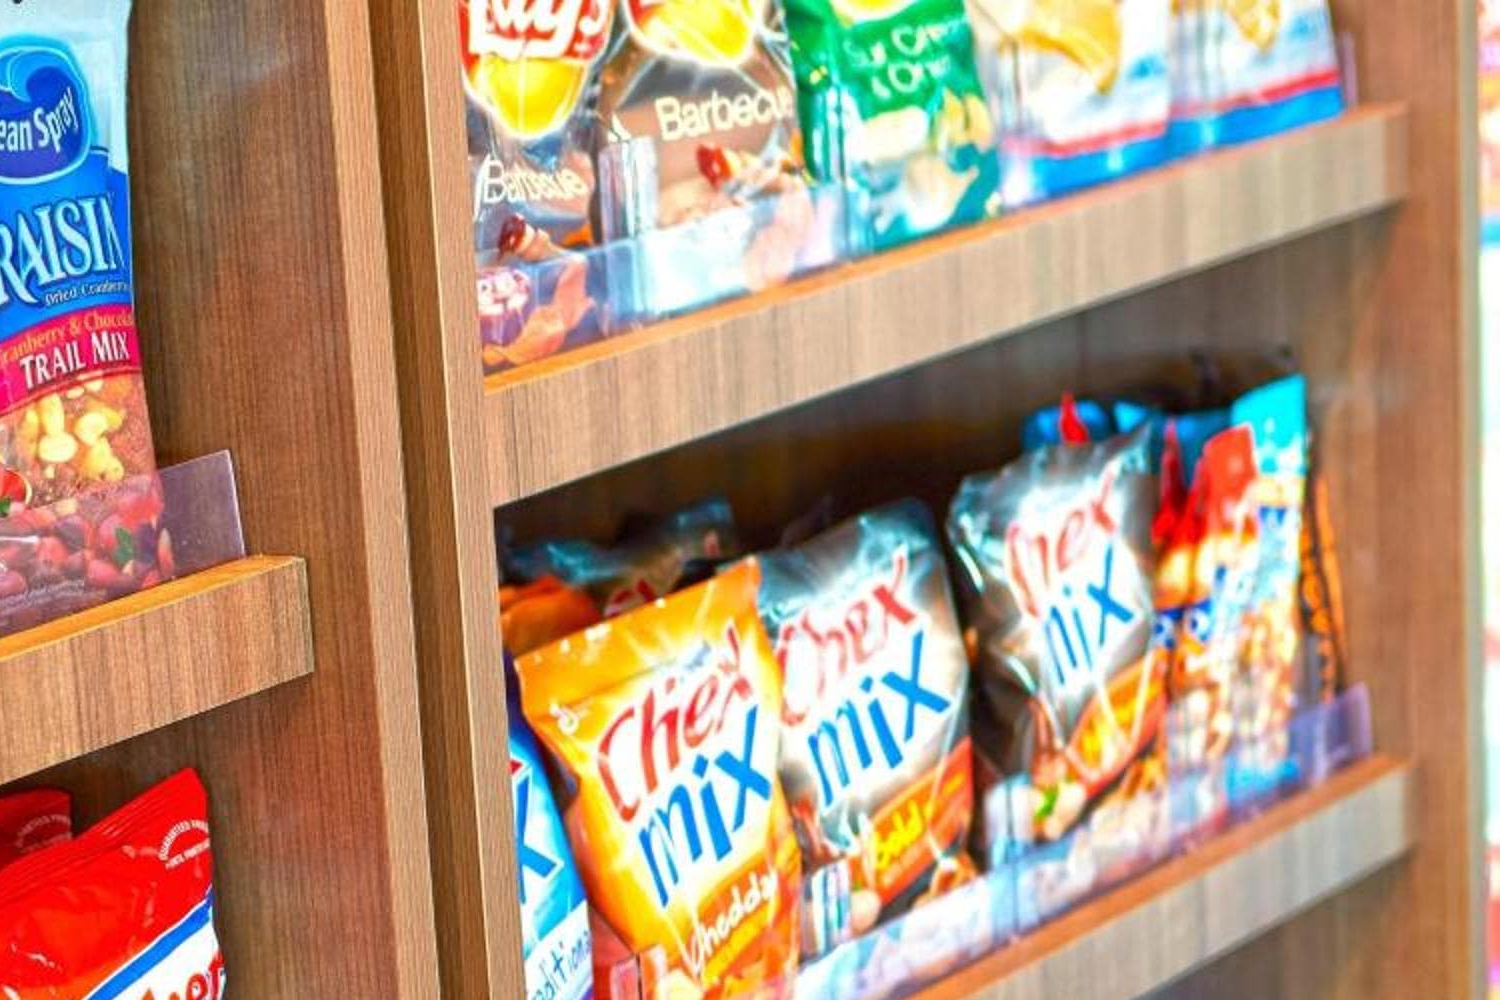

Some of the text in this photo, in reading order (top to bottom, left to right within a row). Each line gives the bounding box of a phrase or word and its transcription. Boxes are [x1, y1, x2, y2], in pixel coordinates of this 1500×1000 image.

[34, 86, 79, 153] Spray
[19, 330, 132, 391] TRAIL MIX
[67, 317, 83, 335] &
[597, 623, 755, 824] Chex
[777, 540, 920, 730] Chex
[805, 630, 952, 810] mix
[635, 702, 774, 910] mix
